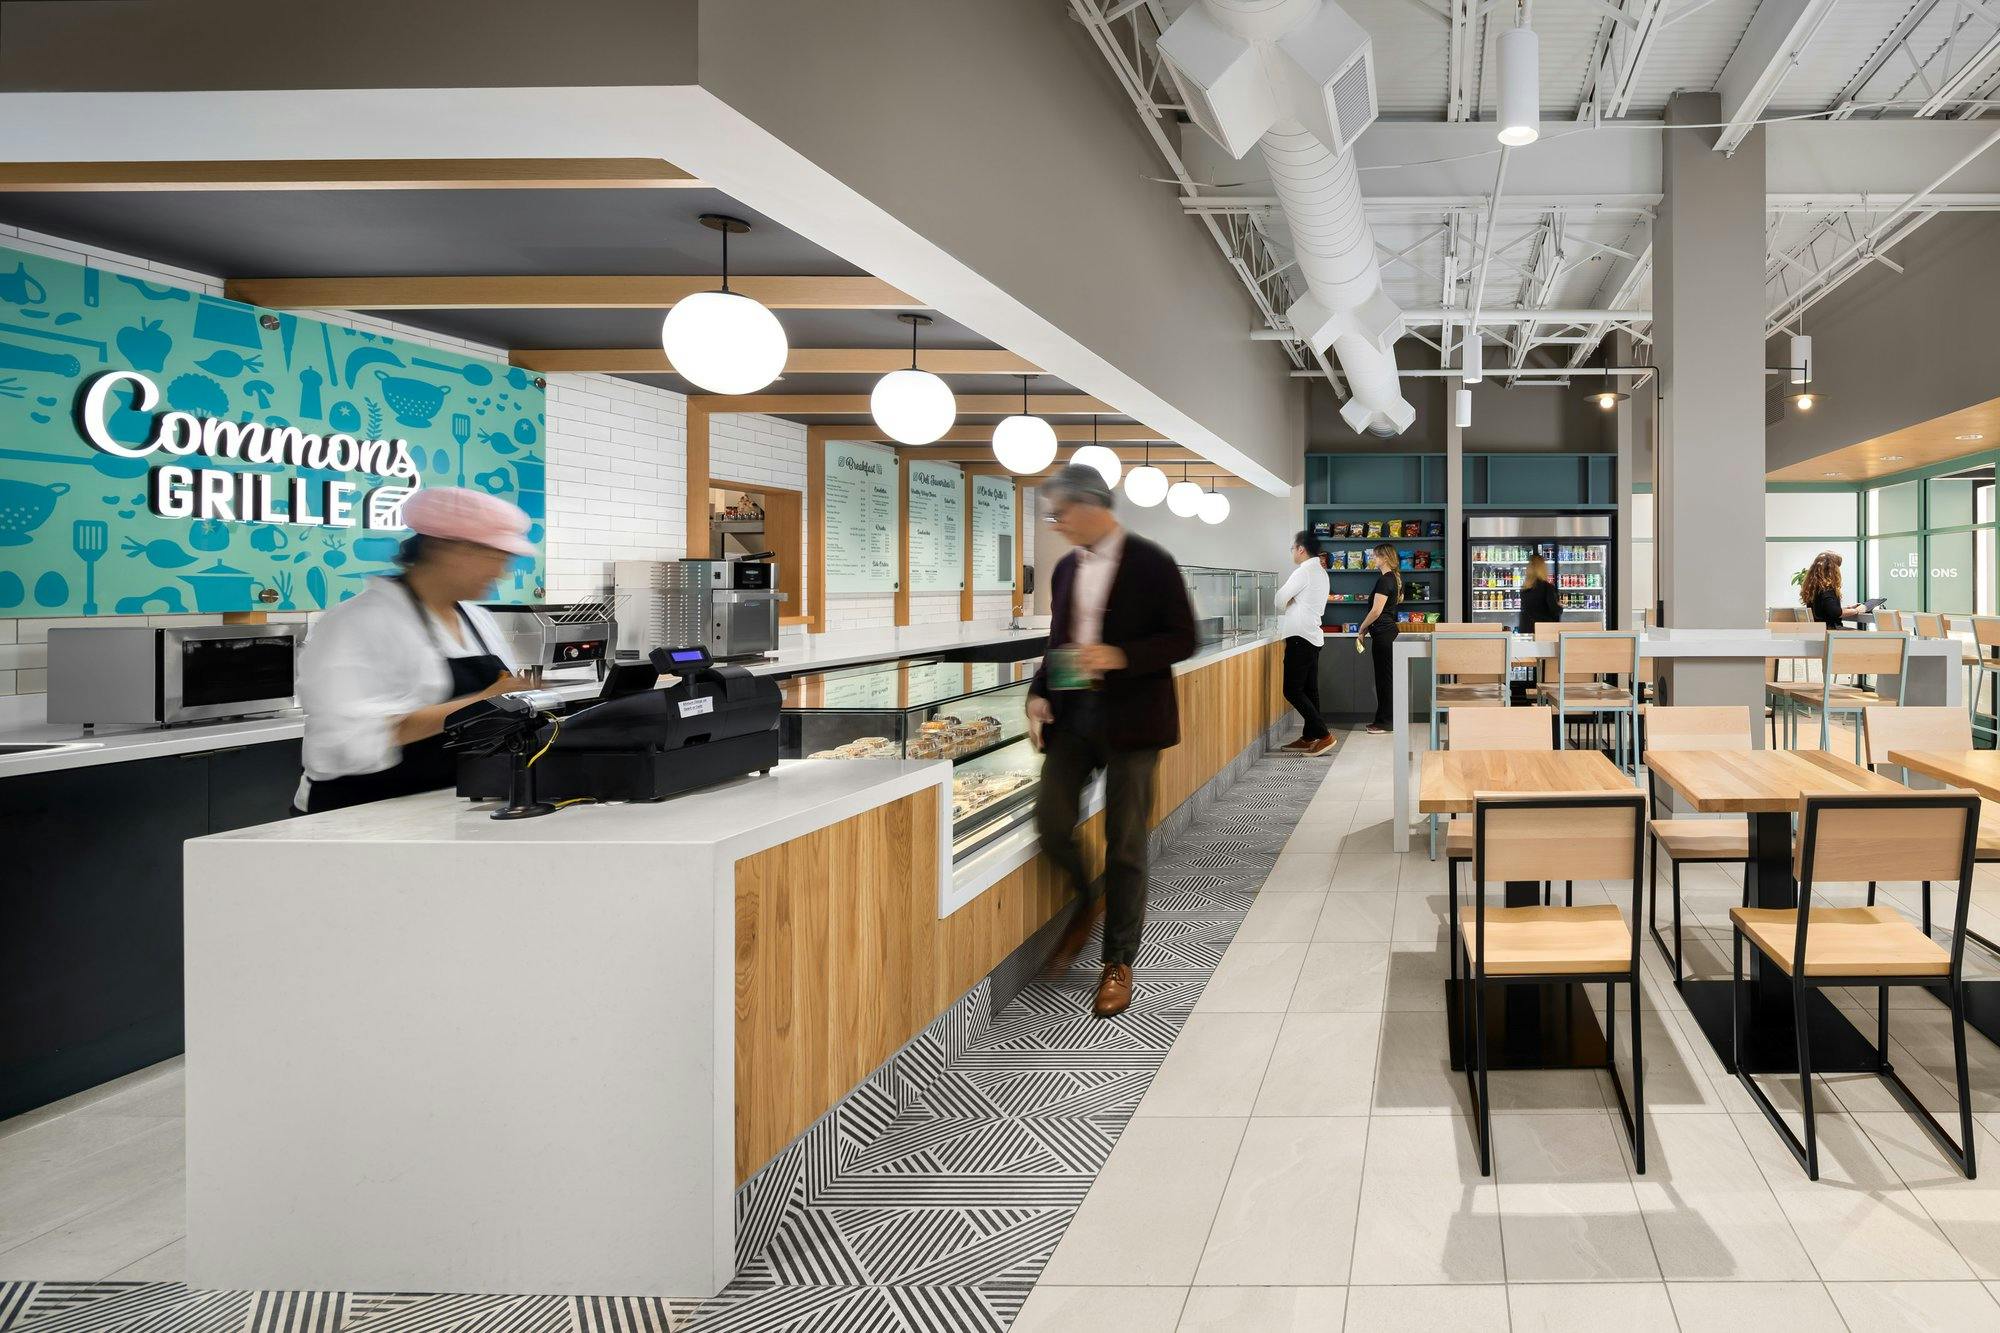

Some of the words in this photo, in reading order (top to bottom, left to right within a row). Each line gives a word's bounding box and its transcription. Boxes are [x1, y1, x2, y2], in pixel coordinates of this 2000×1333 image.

[82, 371, 417, 477] Commons
[846, 456, 876, 476] Breakfast
[155, 466, 357, 528] GRILLE
[1890, 568, 1958, 578] COMONS
